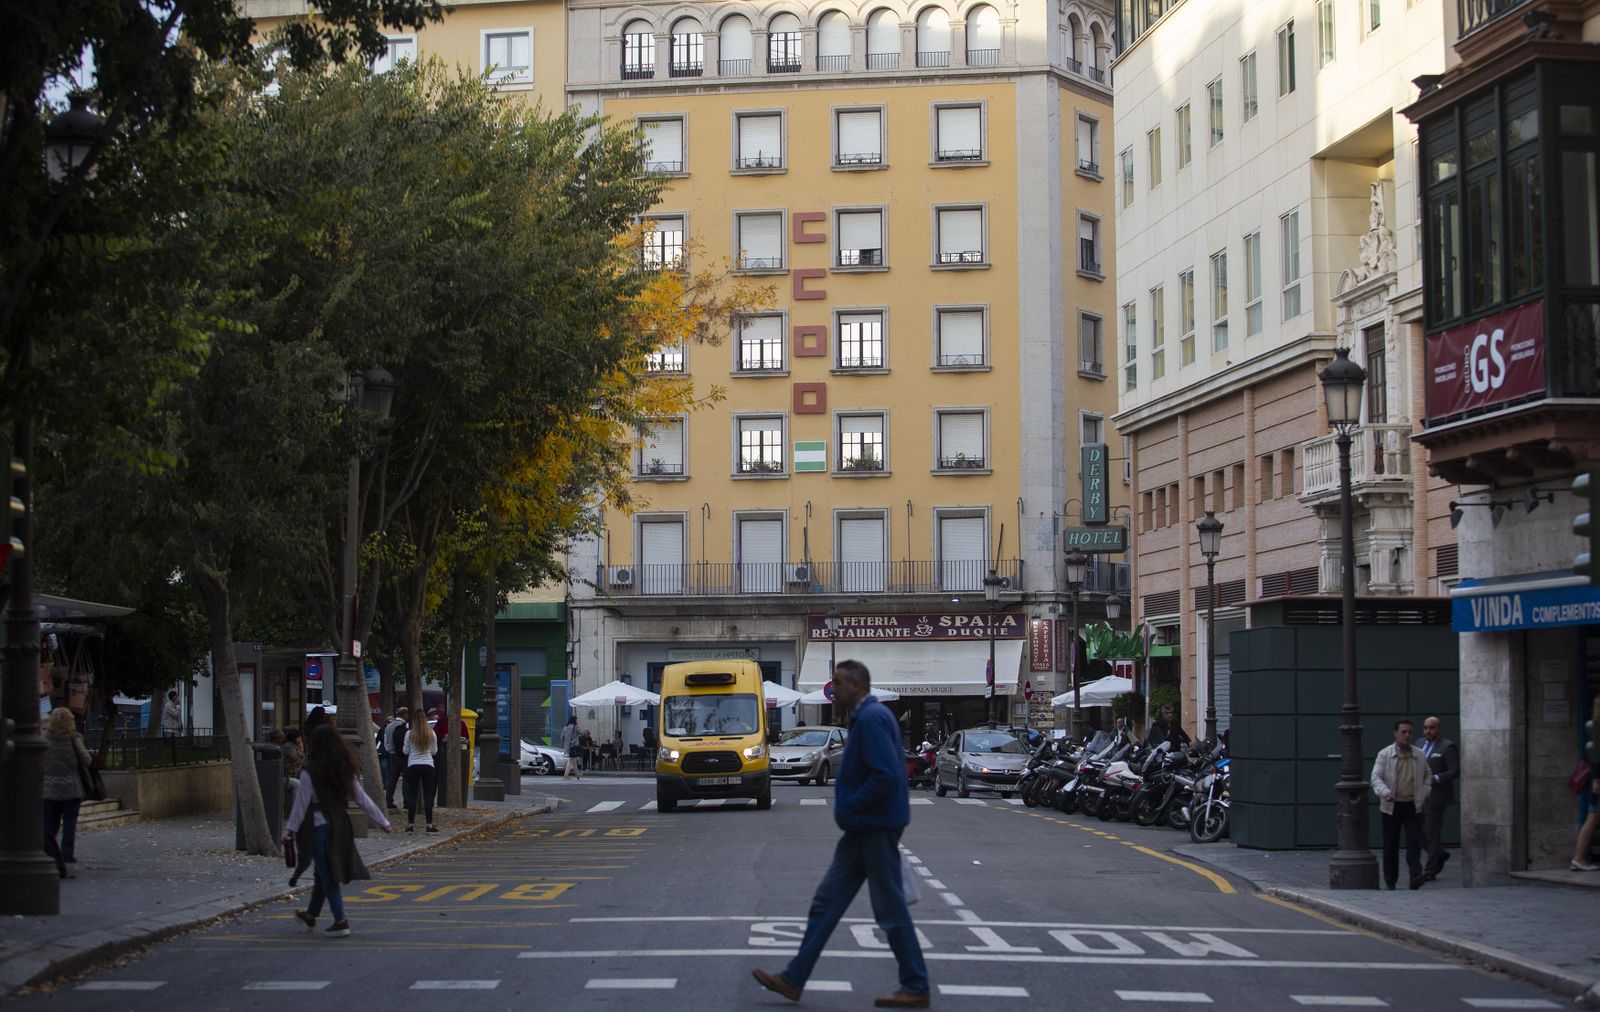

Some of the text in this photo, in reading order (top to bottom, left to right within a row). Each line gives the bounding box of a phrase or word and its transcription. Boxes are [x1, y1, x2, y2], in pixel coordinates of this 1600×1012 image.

[1470, 329, 1505, 393] GS
[1090, 449, 1101, 519] DERBY
[1069, 532, 1121, 545] HOTEL
[939, 615, 1017, 627] SPALA
[1471, 594, 1600, 628] VINDA COMPLEMENTOS
[948, 628, 1008, 637] DUQUE
[343, 882, 577, 902] BUS
[748, 921, 1260, 958] MOTOS
